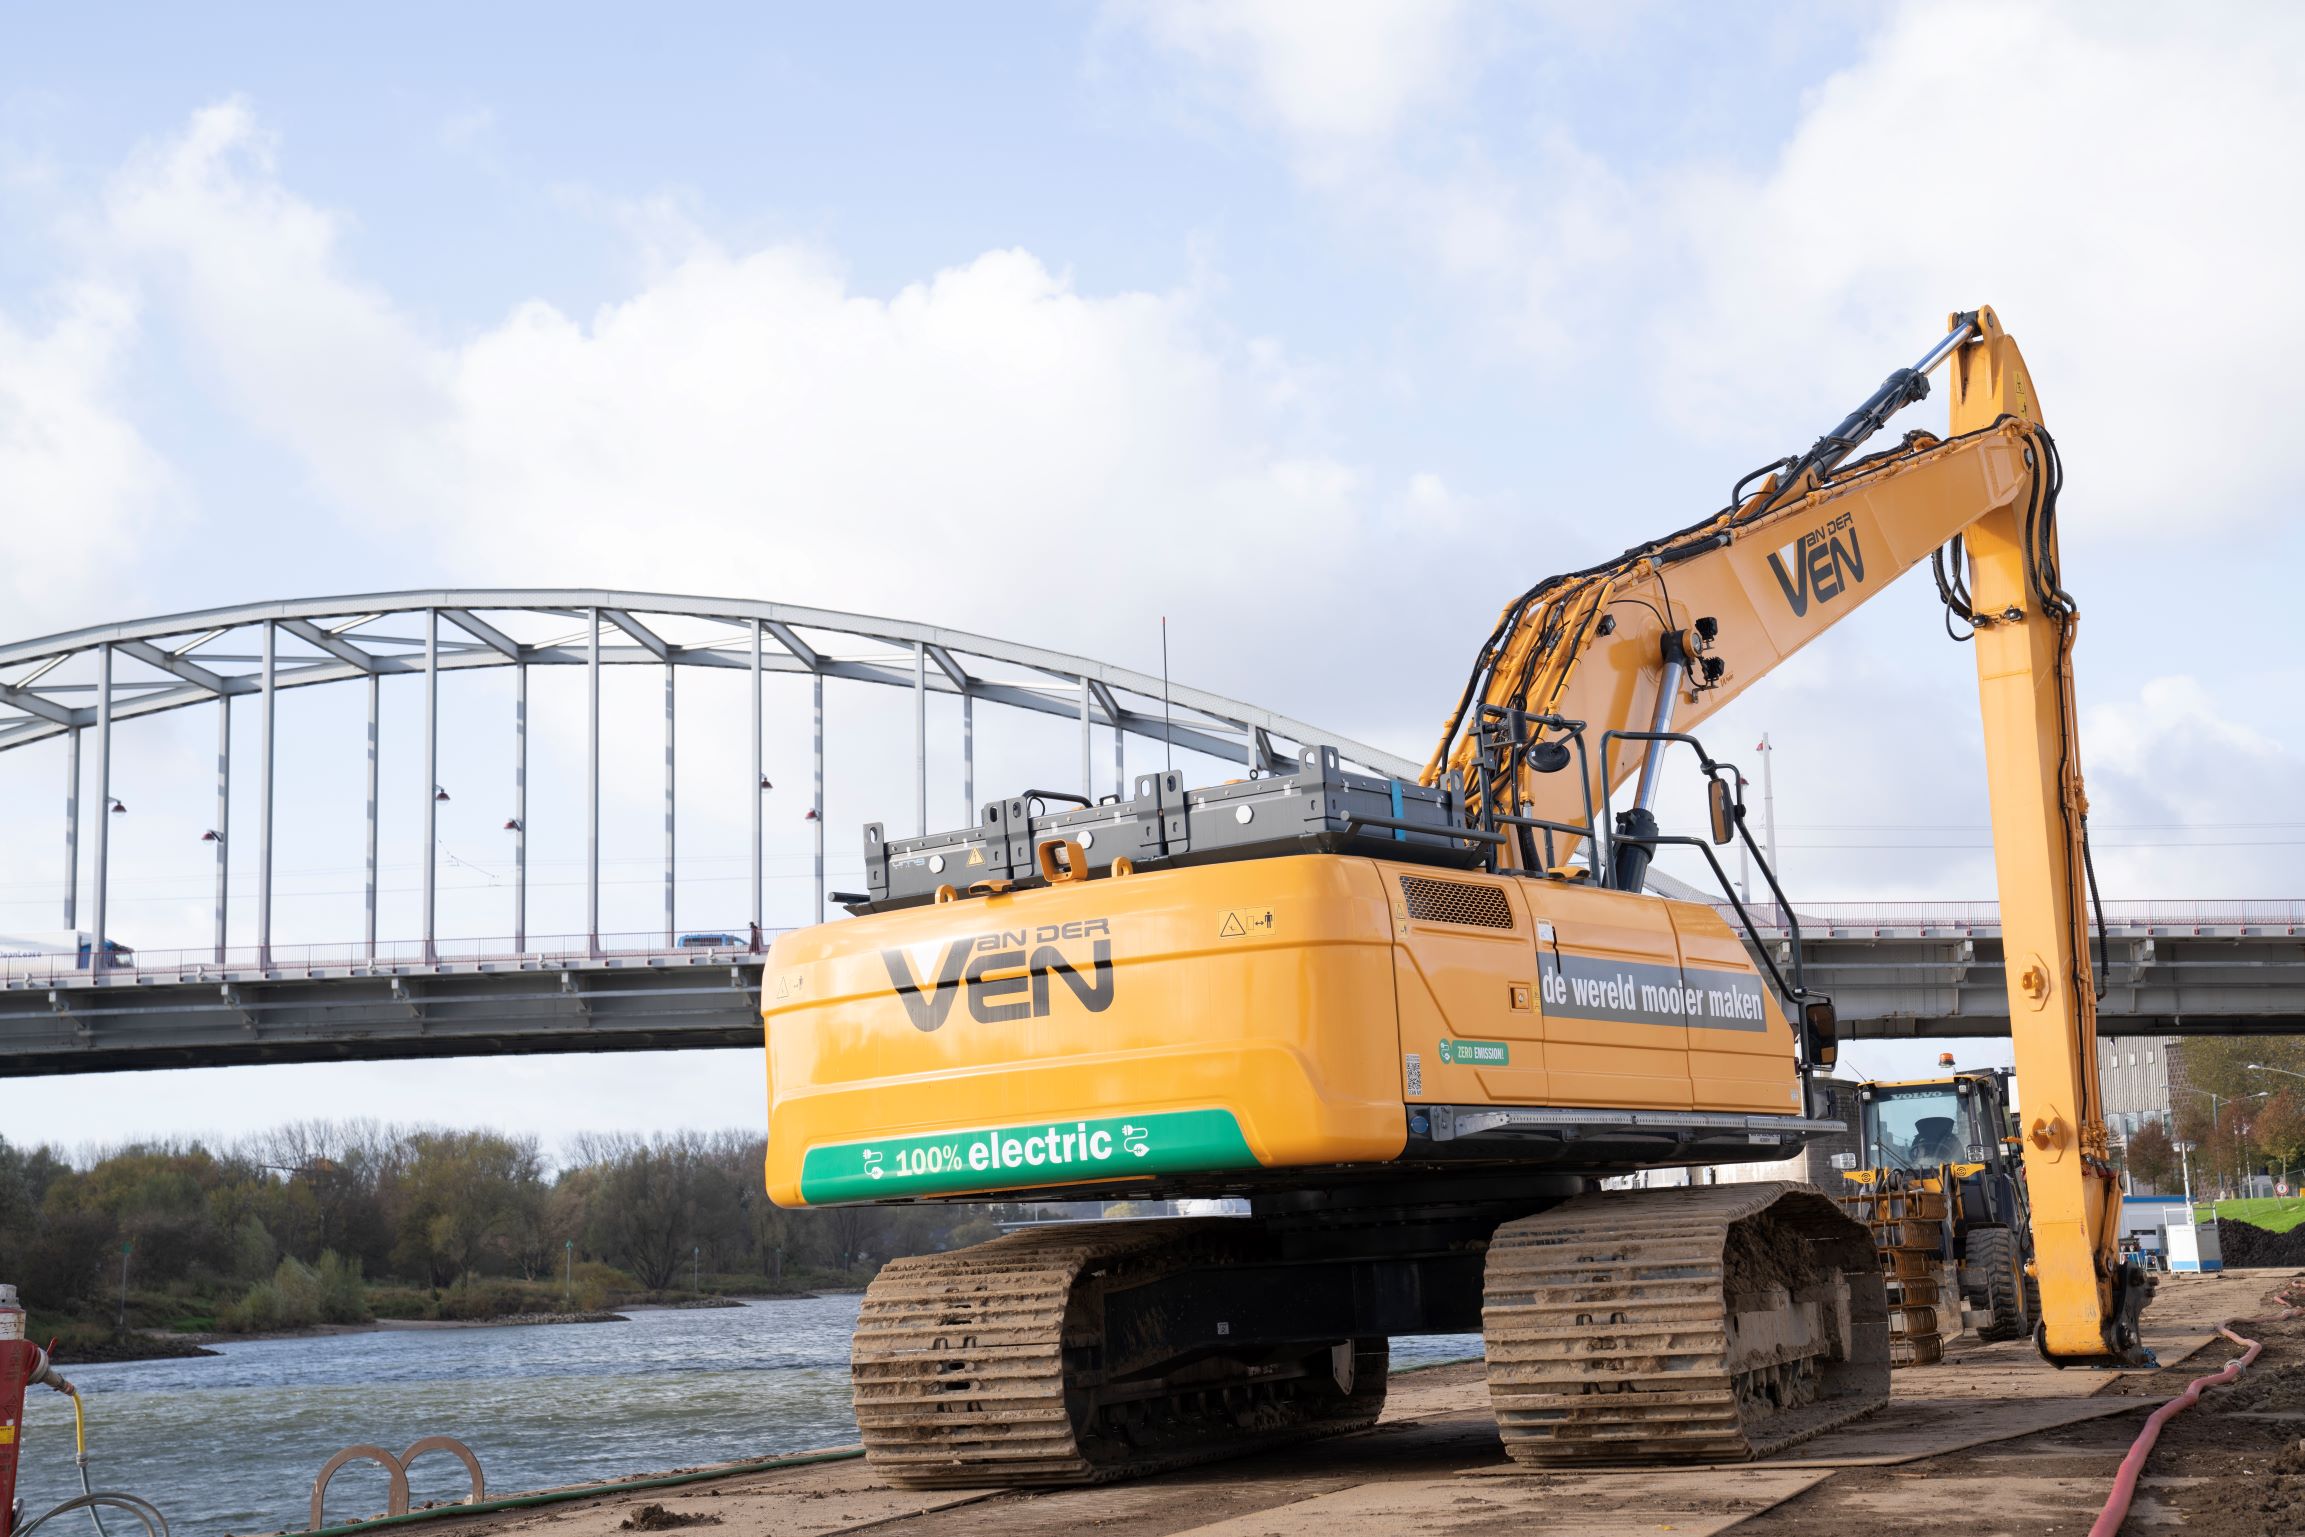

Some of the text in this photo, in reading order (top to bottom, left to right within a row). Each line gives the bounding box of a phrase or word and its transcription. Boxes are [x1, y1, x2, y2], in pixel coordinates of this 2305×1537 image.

[1827, 511, 1854, 536] DER
[1766, 526, 1865, 618] VEN
[1036, 918, 1111, 944] DER
[880, 933, 1115, 1033] VEN
[1542, 966, 1763, 1021] de wereld mooier maken
[1457, 1046, 1473, 1059] ZERO
[1890, 1091, 1943, 1100] VOLVO
[895, 1122, 1113, 1177] 100% electric
